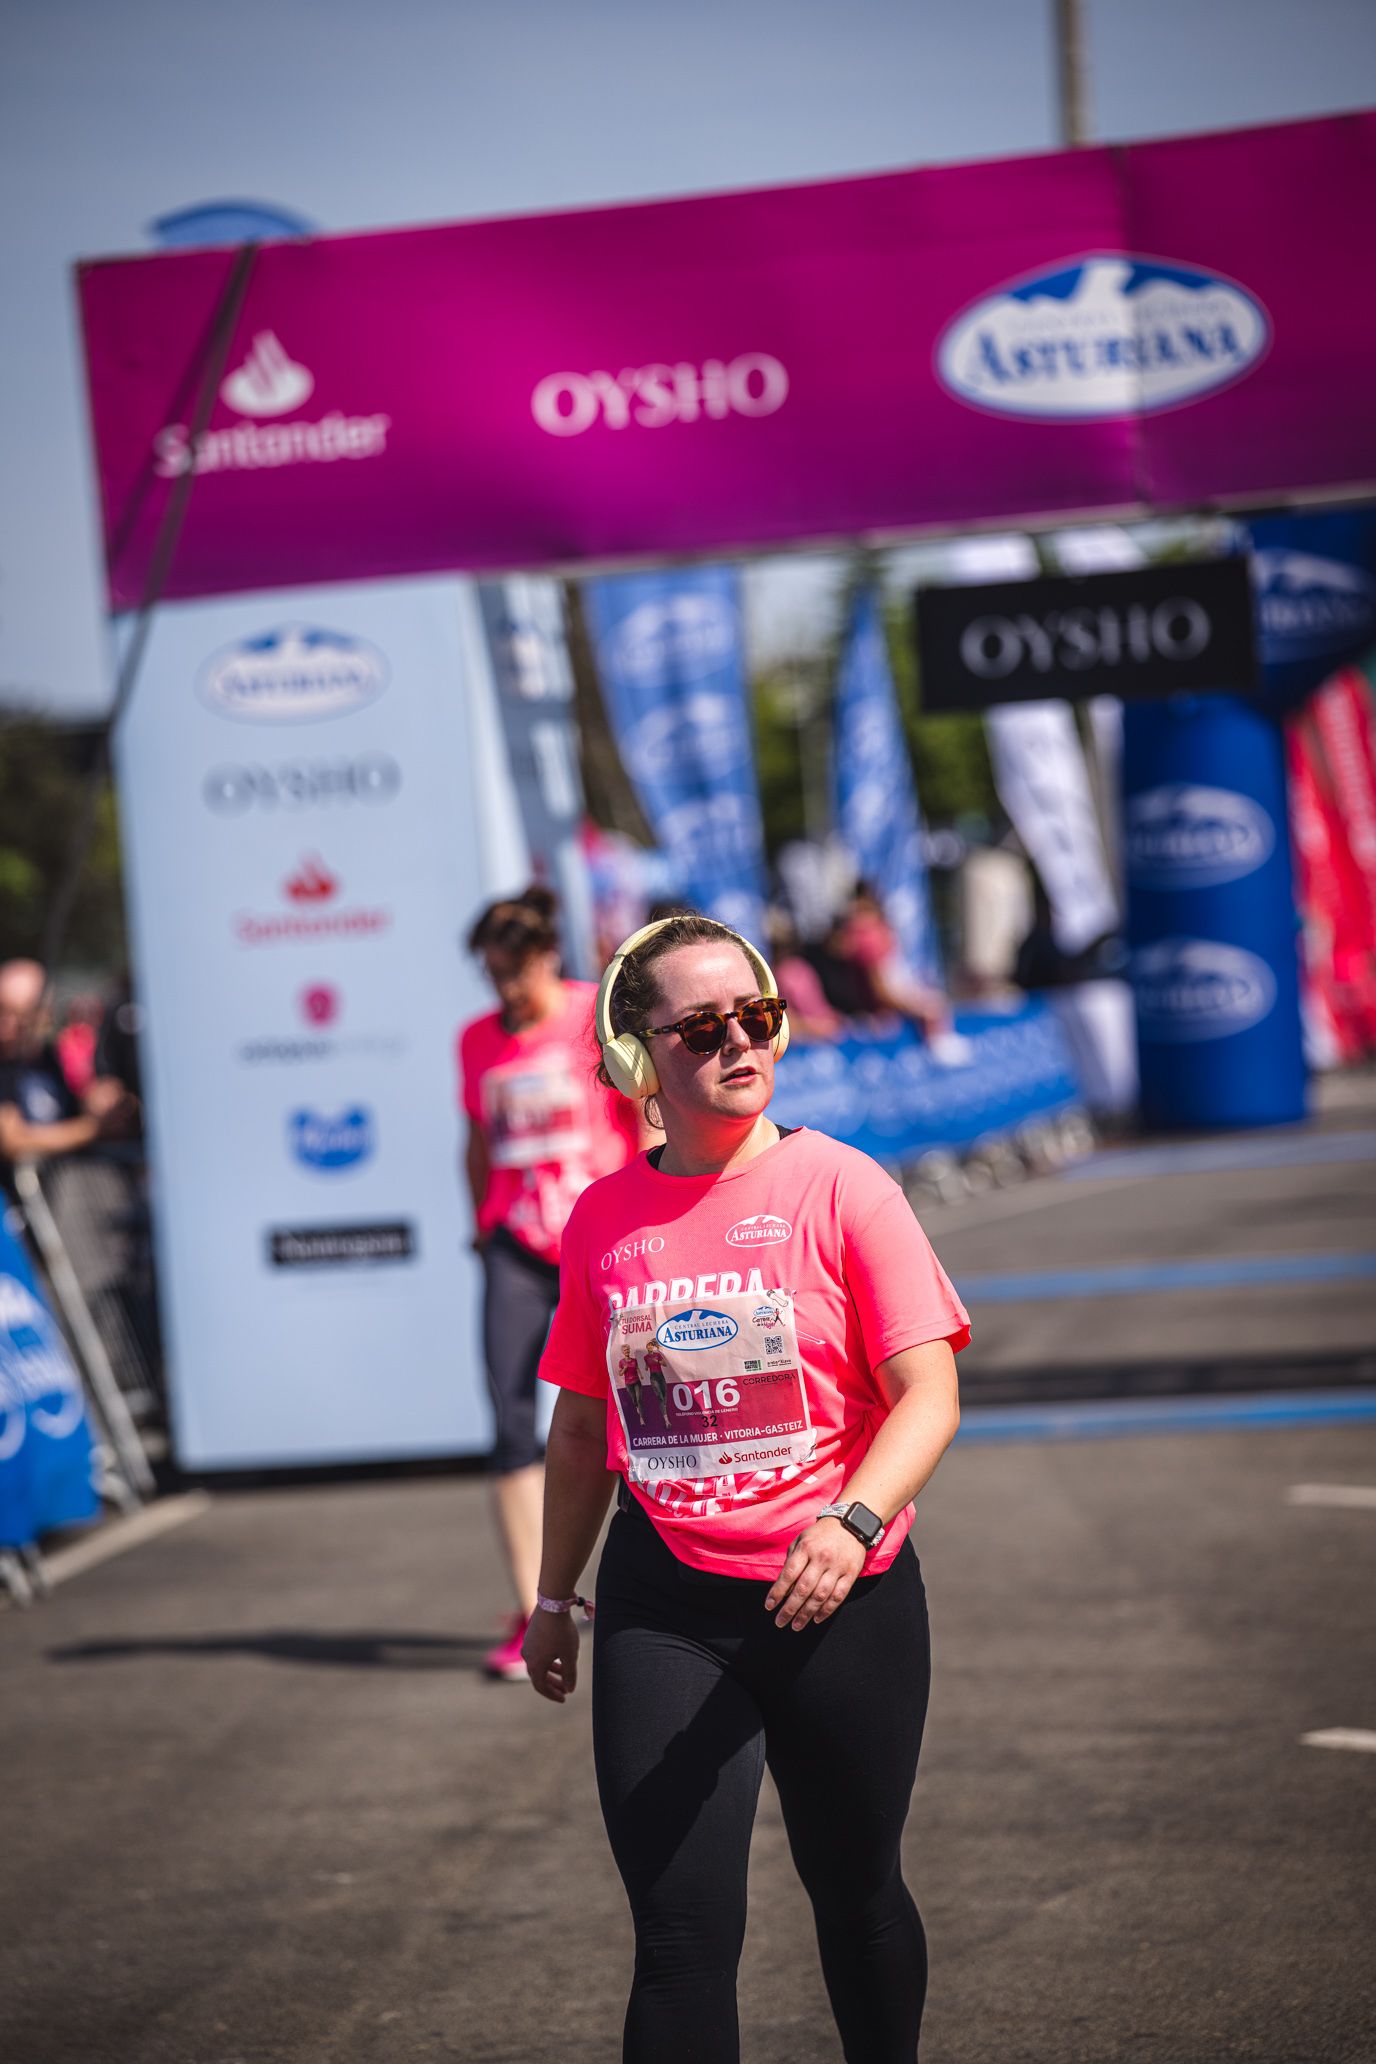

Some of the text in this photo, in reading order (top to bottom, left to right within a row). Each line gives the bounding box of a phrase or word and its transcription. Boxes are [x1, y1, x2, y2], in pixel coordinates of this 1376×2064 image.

[531, 352, 789, 437] OYSHO
[153, 409, 391, 478] Santander
[960, 597, 1211, 680] OYSHO
[202, 750, 402, 818] OYSHO
[730, 1228, 787, 1242] ASTURIANA
[601, 1236, 665, 1271] OYSHO
[629, 1314, 652, 1323] DORSAL
[674, 1319, 729, 1330] CENTRAL LECHERA
[622, 1321, 653, 1335] SUMA
[663, 1325, 733, 1343] ASTURIANA
[742, 1374, 796, 1386] CORREDORA
[672, 1379, 741, 1411] 016
[702, 1415, 718, 1428] 32
[633, 1420, 804, 1447] CARRERA DE LA MUJER VITORIA-GASTEIZ
[647, 1454, 697, 1470] OYSHO
[734, 1445, 792, 1463] Santander
